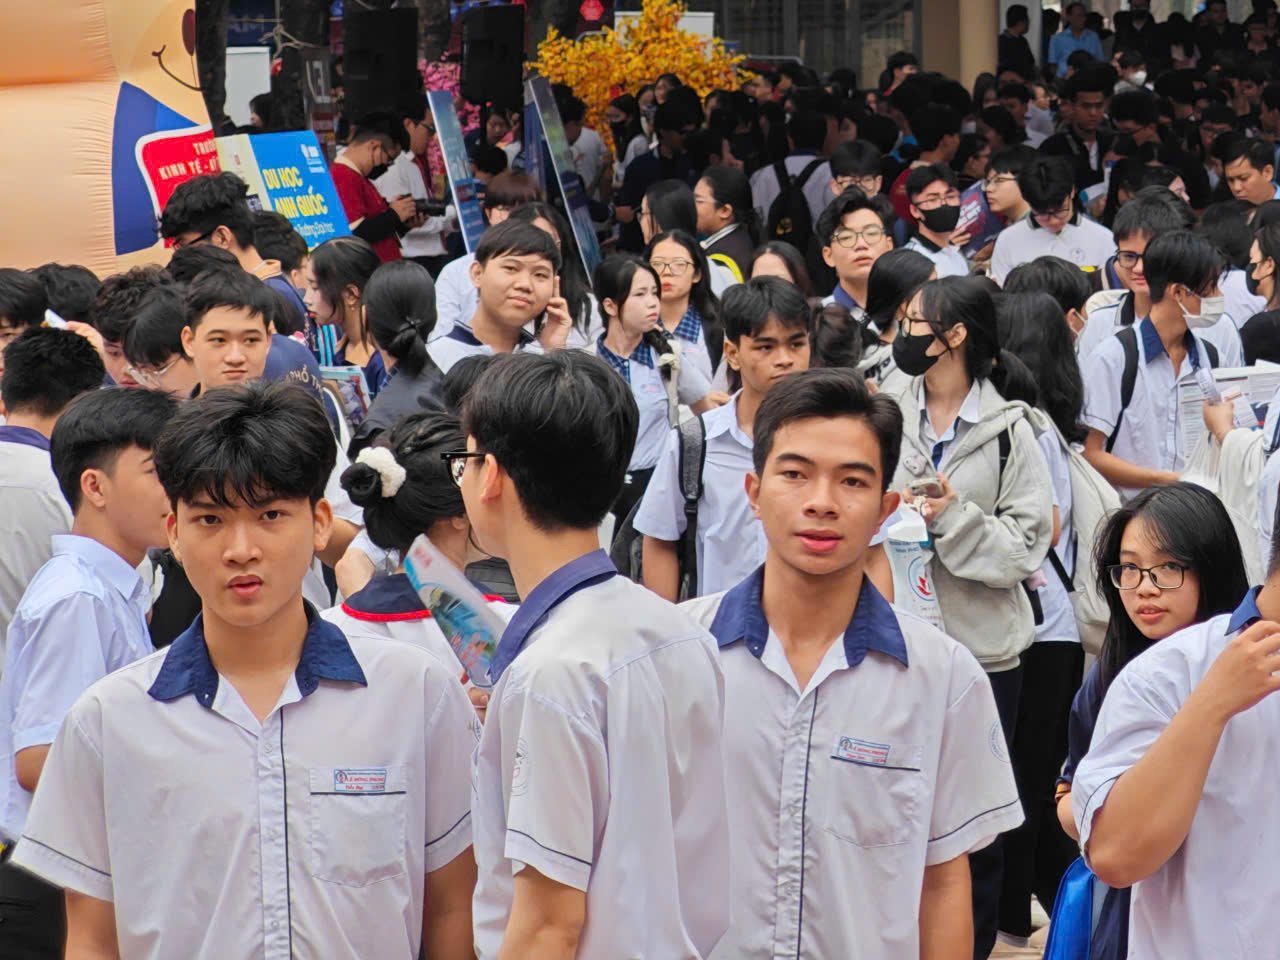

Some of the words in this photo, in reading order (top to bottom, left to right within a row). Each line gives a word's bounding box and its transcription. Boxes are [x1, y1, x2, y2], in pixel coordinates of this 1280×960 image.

[158, 164, 187, 180] KINH
[262, 169, 280, 190] DU
[281, 166, 304, 192] HỌC
[274, 197, 297, 217] ANH
[296, 186, 328, 216] QUỐC
